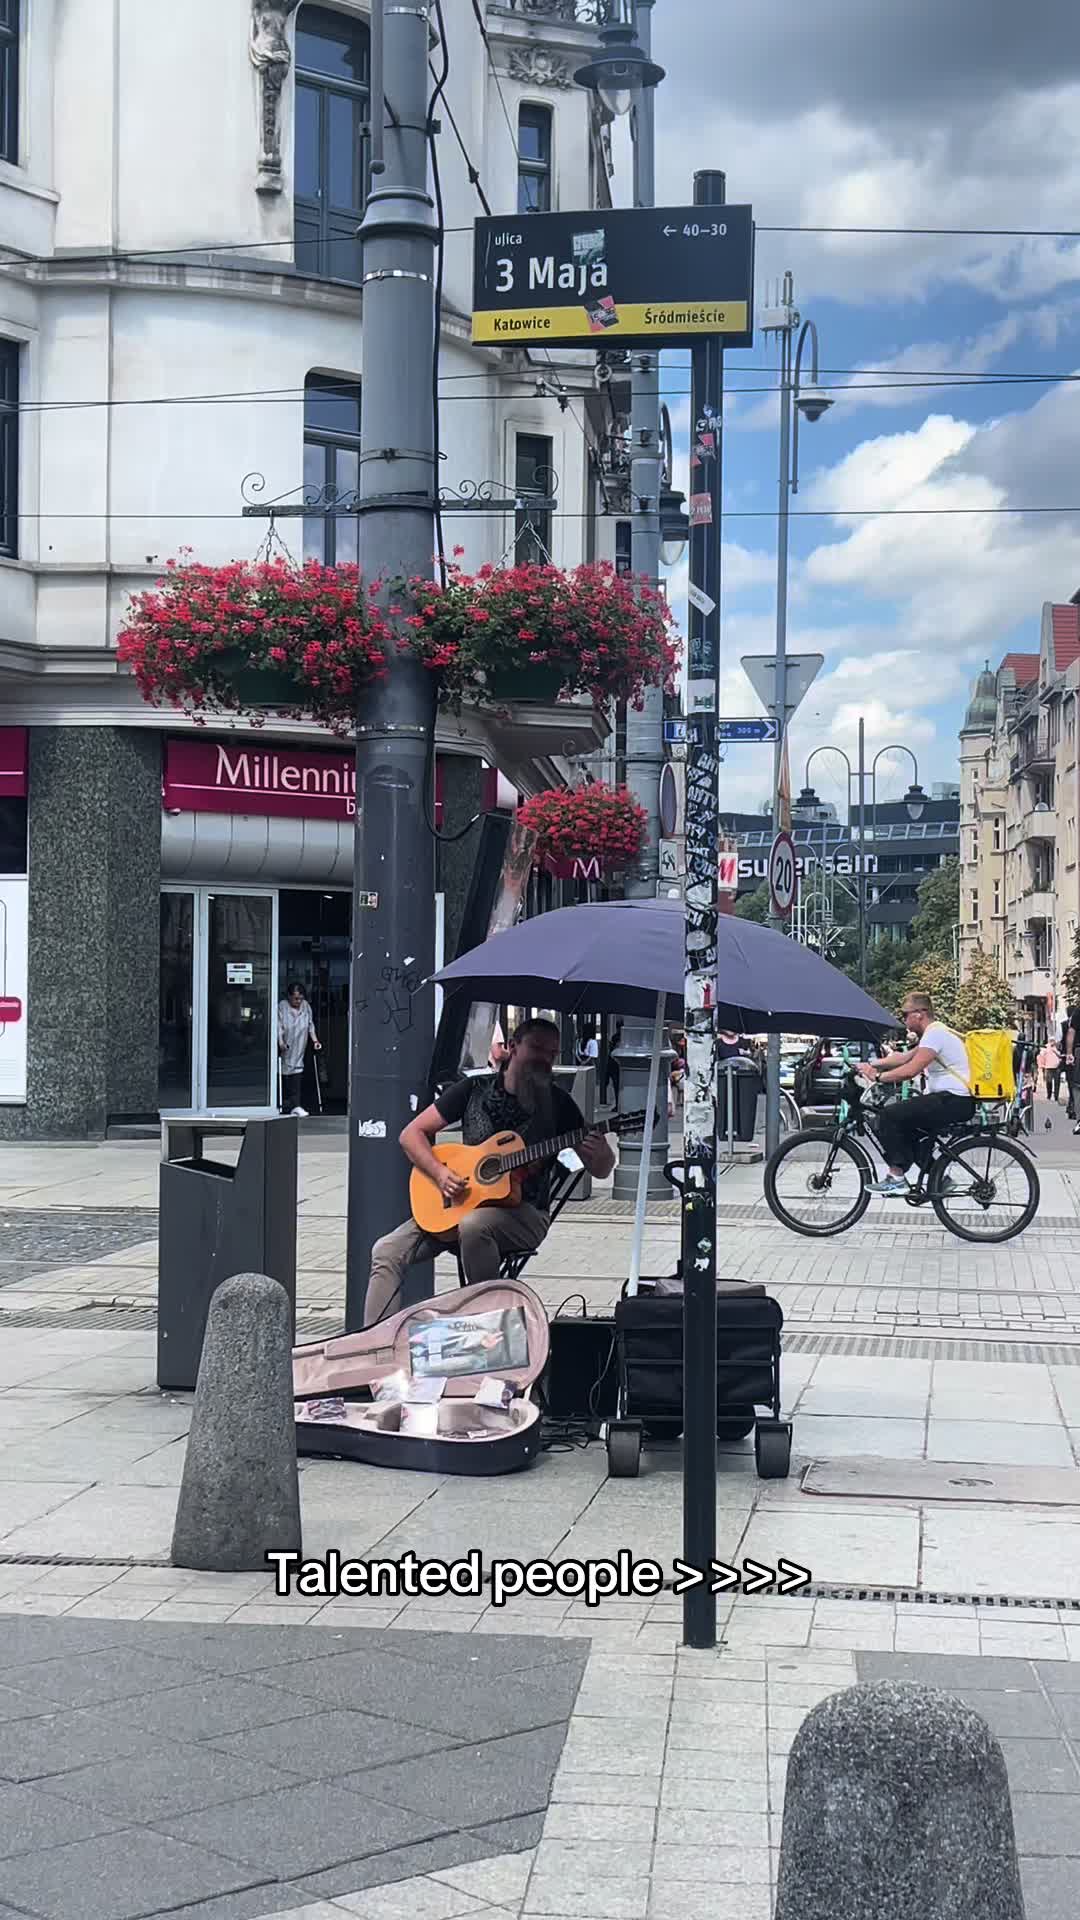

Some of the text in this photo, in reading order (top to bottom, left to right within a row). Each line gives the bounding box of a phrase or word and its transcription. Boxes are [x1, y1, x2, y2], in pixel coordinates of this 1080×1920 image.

[495, 233, 523, 247] ulica
[495, 256, 608, 296] 3 Maja
[493, 317, 551, 332] Katowice
[644, 309, 726, 325] Śródmieście
[215, 744, 356, 794] Millenni
[572, 857, 601, 879] M
[738, 854, 878, 878] suersam
[775, 856, 792, 894] 20
[984, 1050, 992, 1081] Govo
